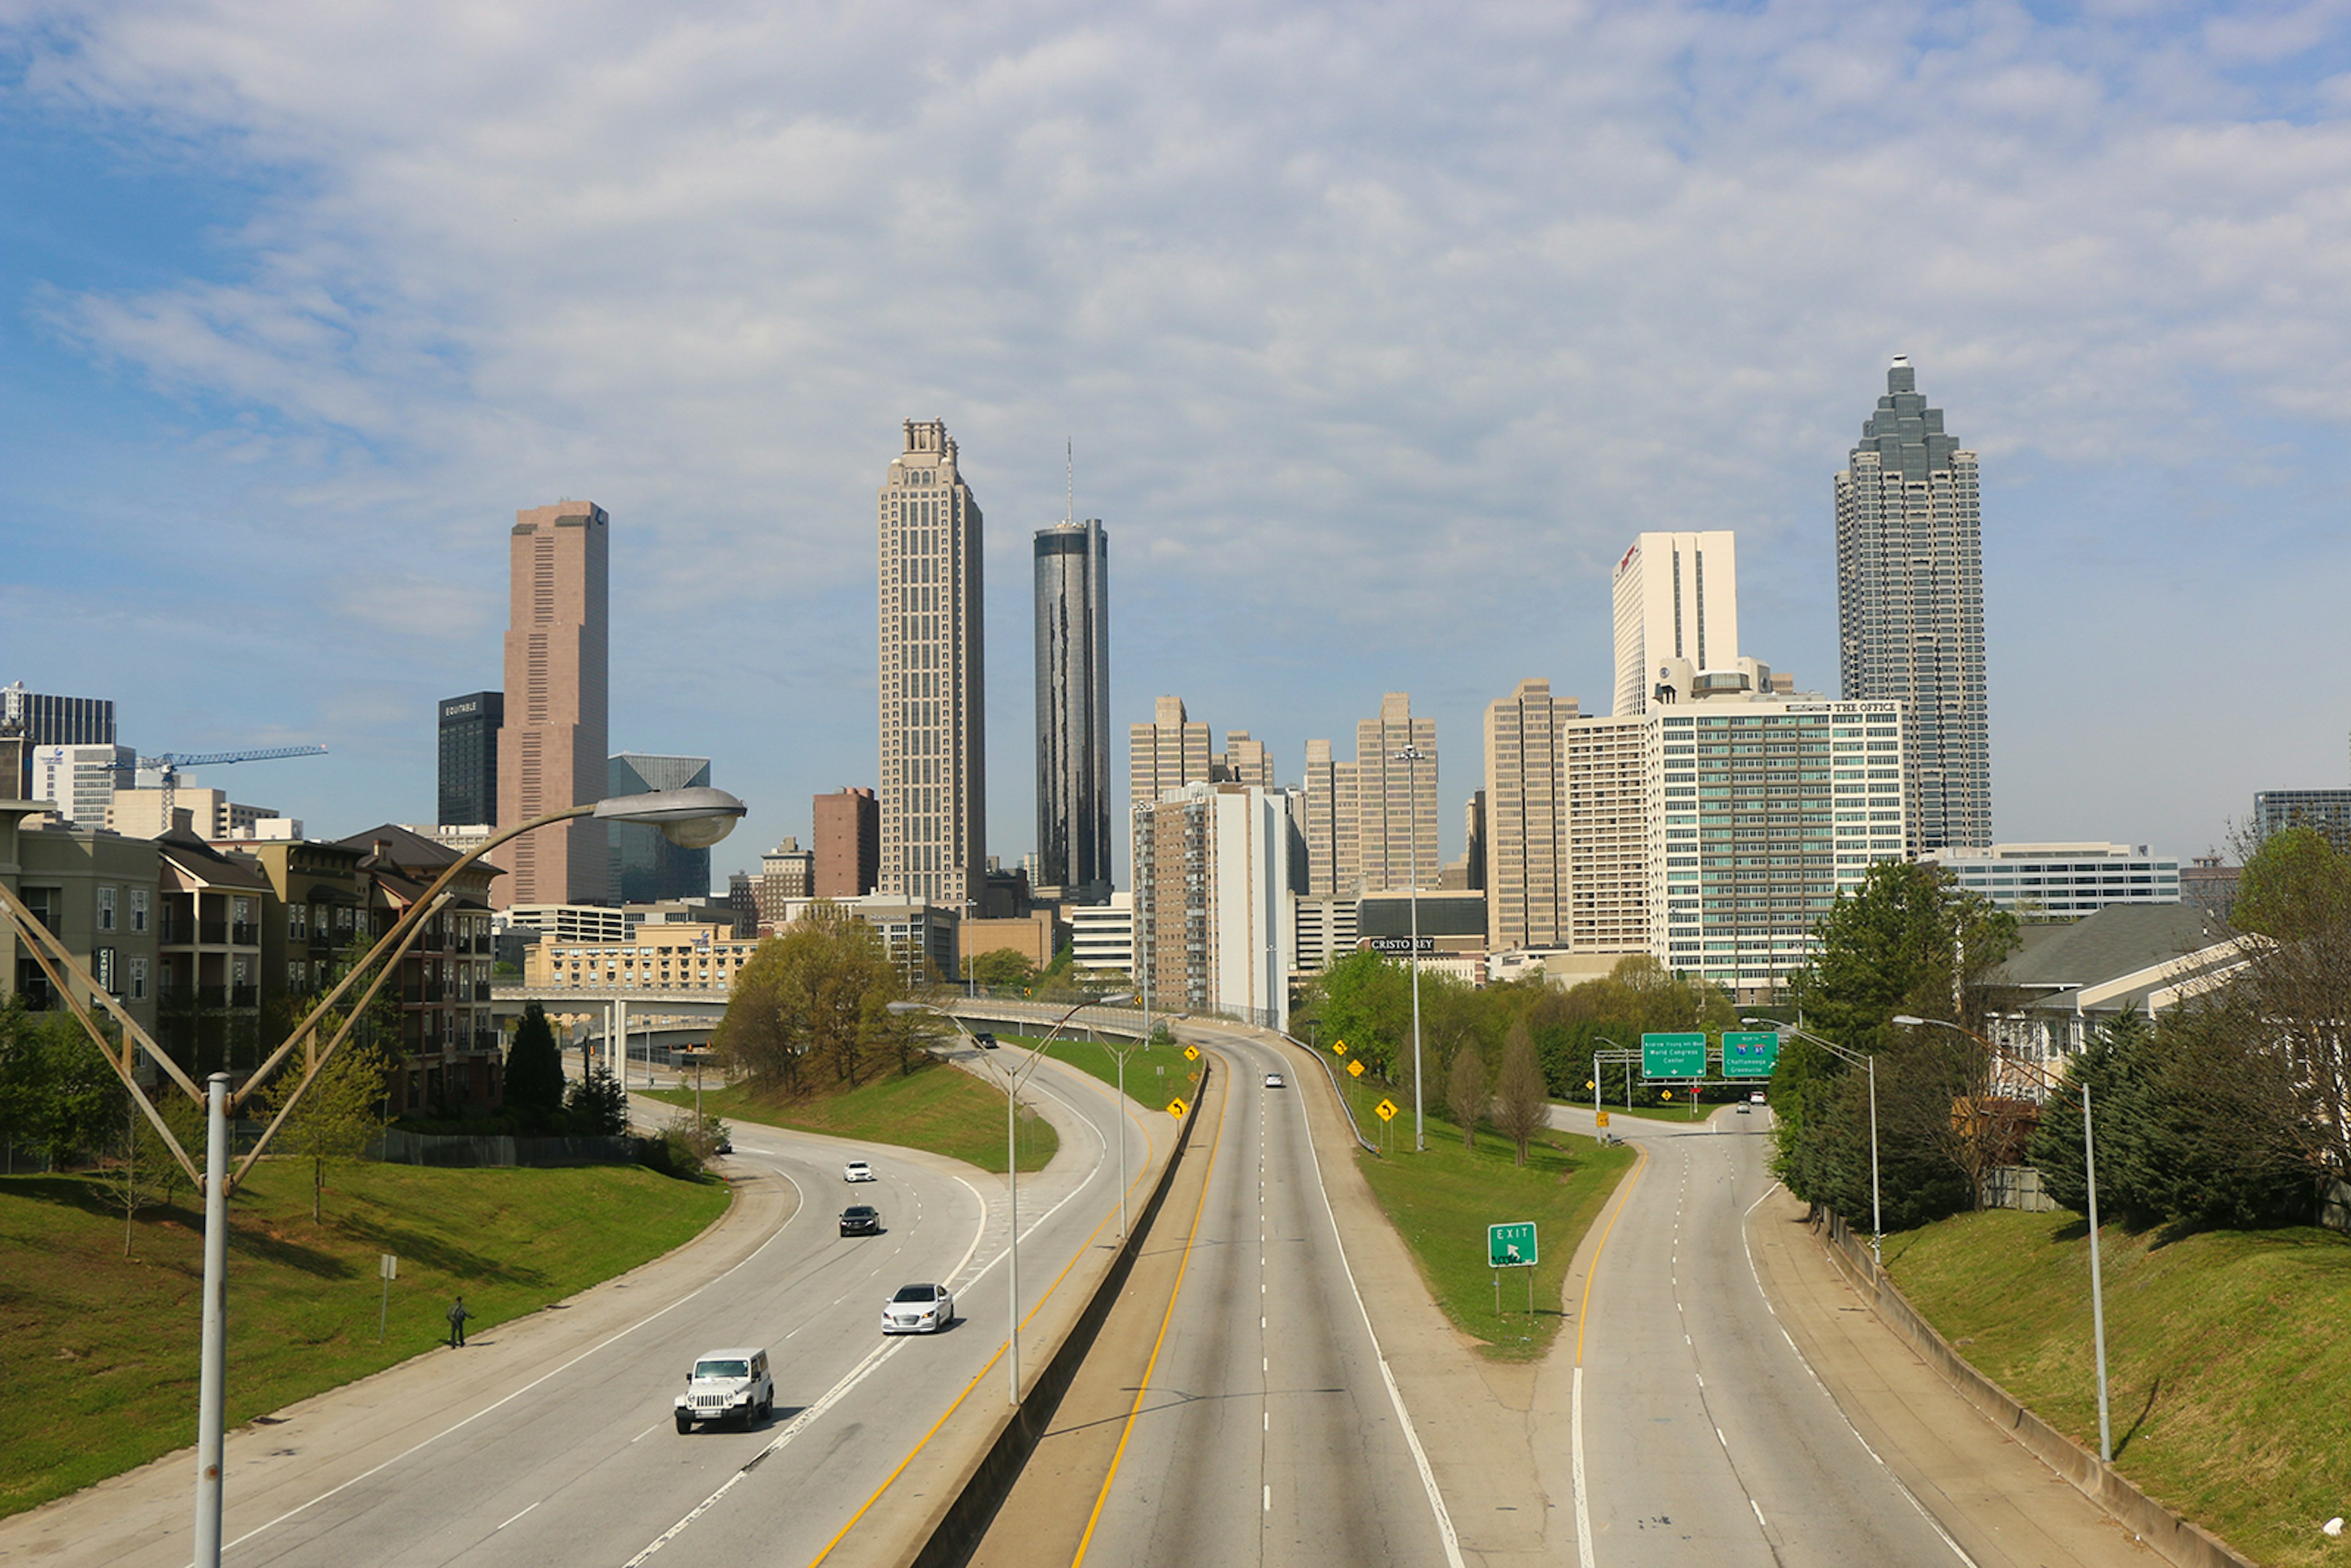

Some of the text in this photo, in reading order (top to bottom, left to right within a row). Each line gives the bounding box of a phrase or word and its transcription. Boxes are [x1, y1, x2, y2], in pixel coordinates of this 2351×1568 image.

[446, 702, 476, 717] EQUITABLE
[1860, 703, 1896, 712] OFFICE
[1371, 939, 1410, 950] CRISTO
[1497, 1227, 1528, 1240] EXIT
